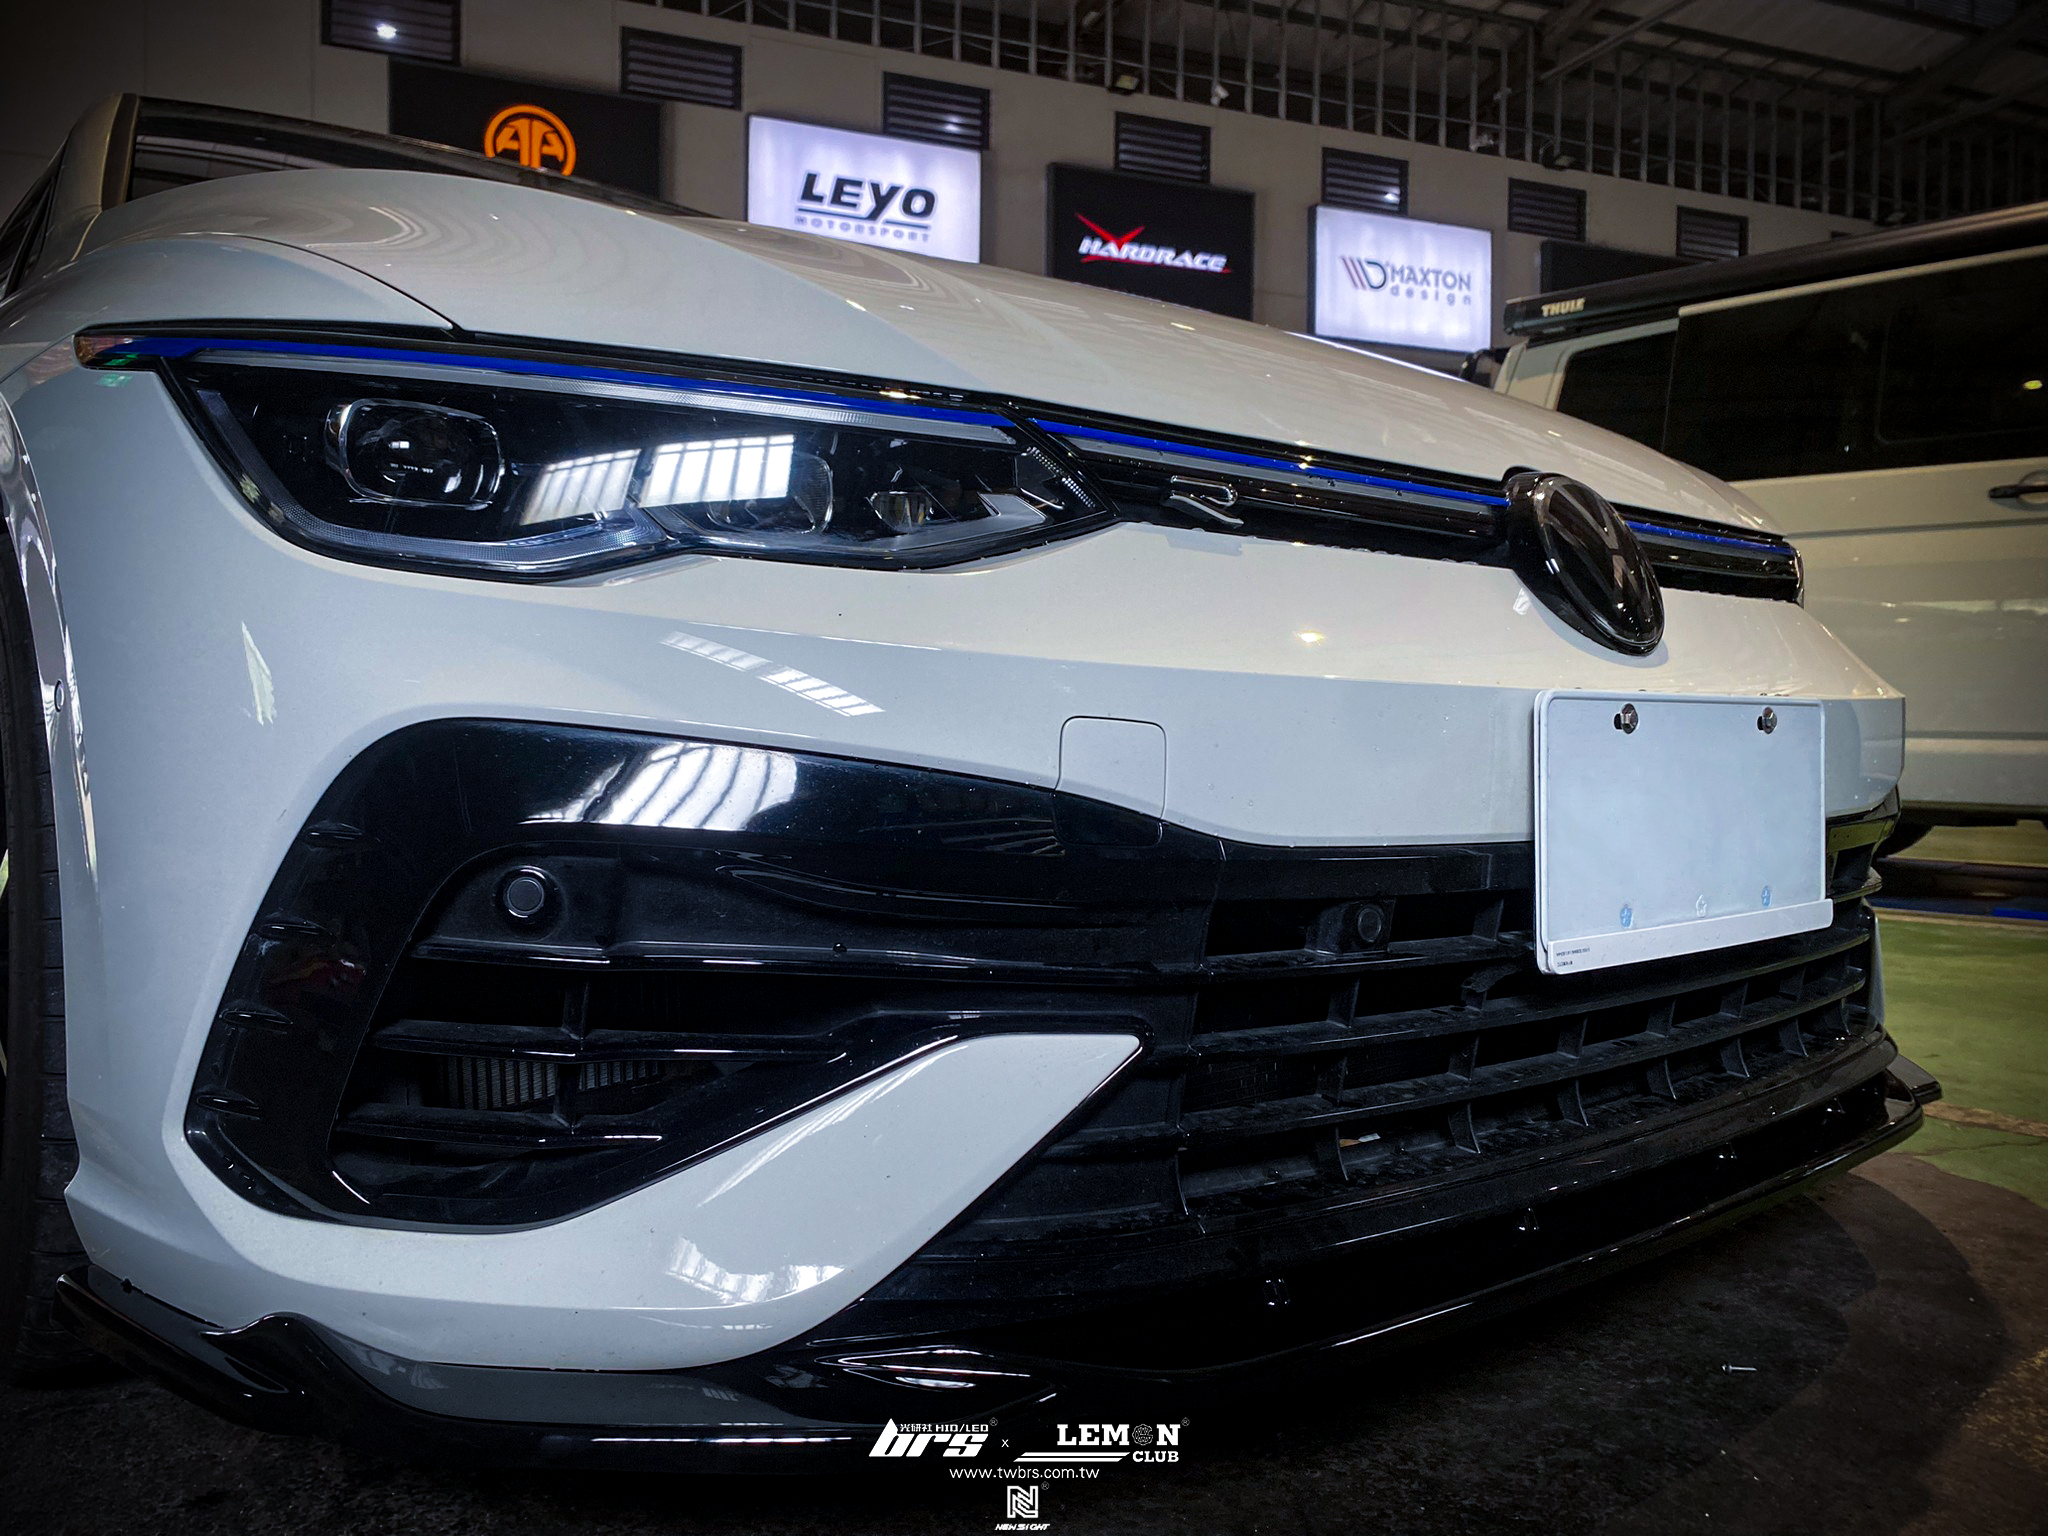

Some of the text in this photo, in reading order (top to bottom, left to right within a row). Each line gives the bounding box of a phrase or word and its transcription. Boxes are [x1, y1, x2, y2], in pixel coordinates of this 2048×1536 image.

[795, 215, 930, 243] MOTORSPORT
[1078, 235, 1228, 273] HARDRACE
[1390, 264, 1472, 292] MAXTON
[1389, 284, 1472, 306] design
[1541, 297, 1586, 318] THULE
